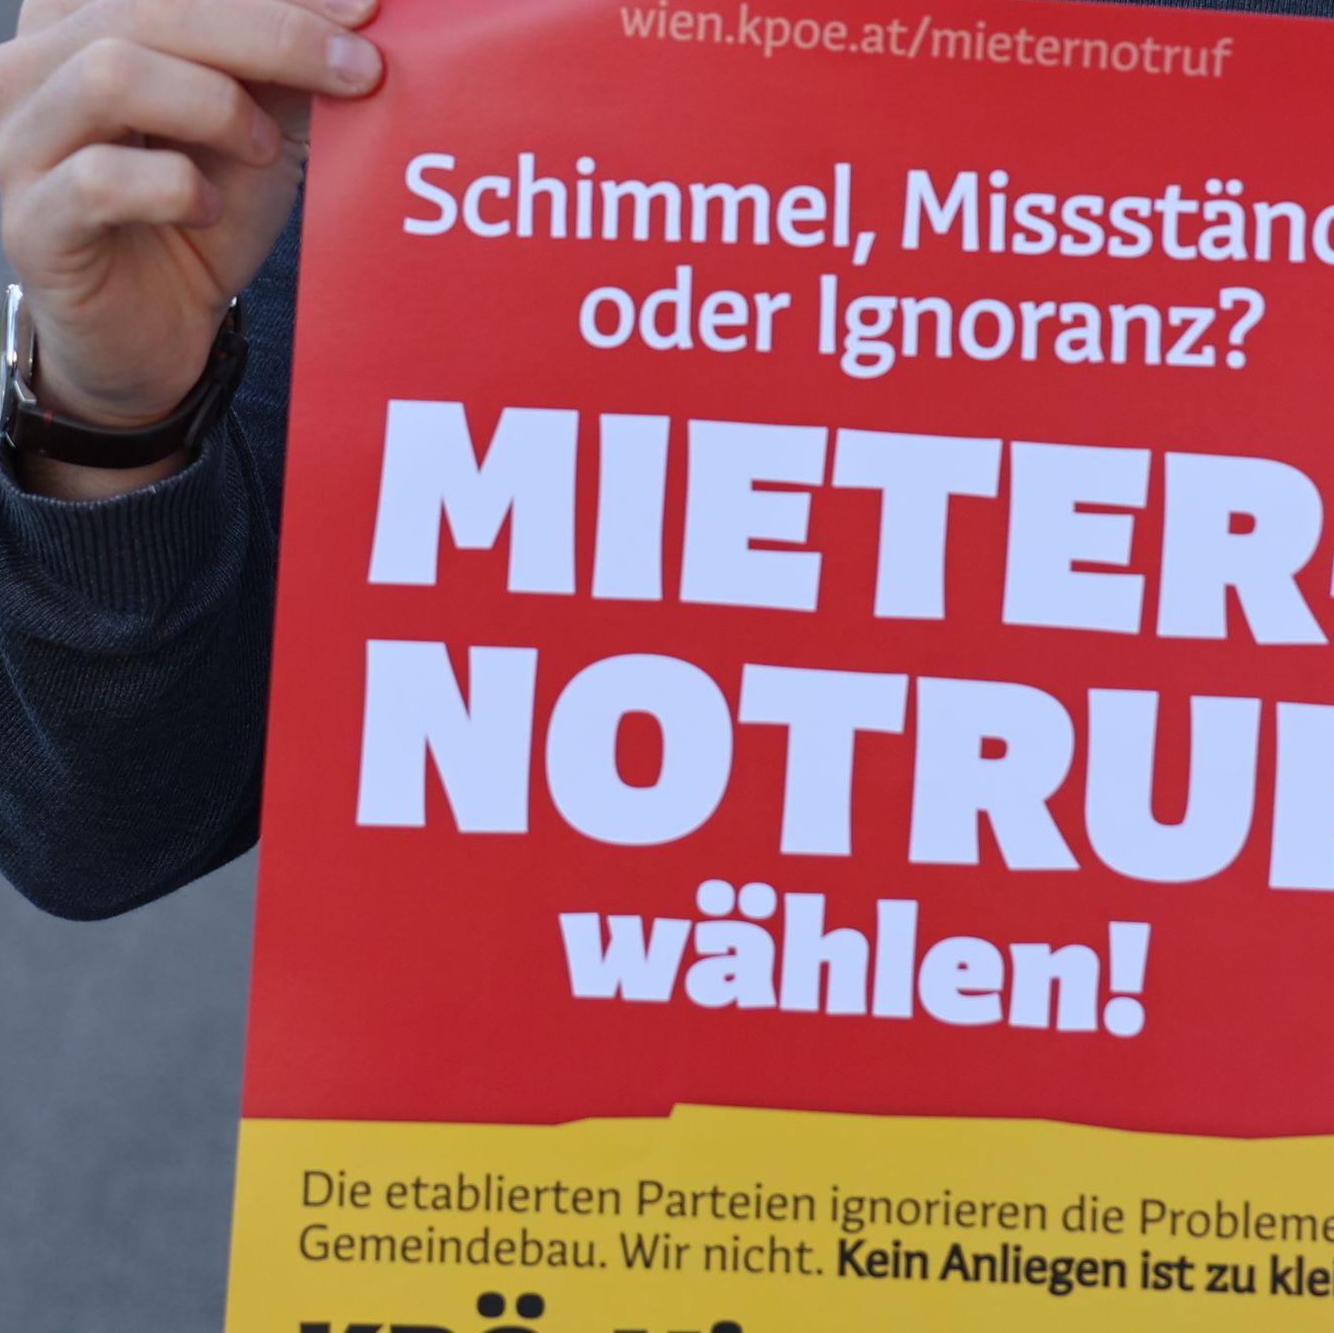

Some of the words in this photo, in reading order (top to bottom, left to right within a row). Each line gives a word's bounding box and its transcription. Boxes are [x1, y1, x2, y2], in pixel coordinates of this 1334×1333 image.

[402, 152, 876, 266] Schimmel,
[579, 266, 791, 352] oder
[818, 274, 1265, 379] Ignoranz?
[559, 879, 1151, 1037] wählen!
[302, 1170, 372, 1209] Die
[385, 1172, 621, 1215] etablierten
[637, 1179, 816, 1222] Parteien
[831, 1185, 1047, 1235] ignorieren
[1061, 1193, 1124, 1235] die
[299, 1223, 607, 1269] Gemeindebau.
[619, 1232, 690, 1270] Wir
[704, 1235, 823, 1276] nicht.
[837, 1237, 930, 1281] Kein
[938, 1241, 1128, 1298] Anliegen
[1140, 1249, 1196, 1293] ist
[1204, 1262, 1257, 1295] zu
